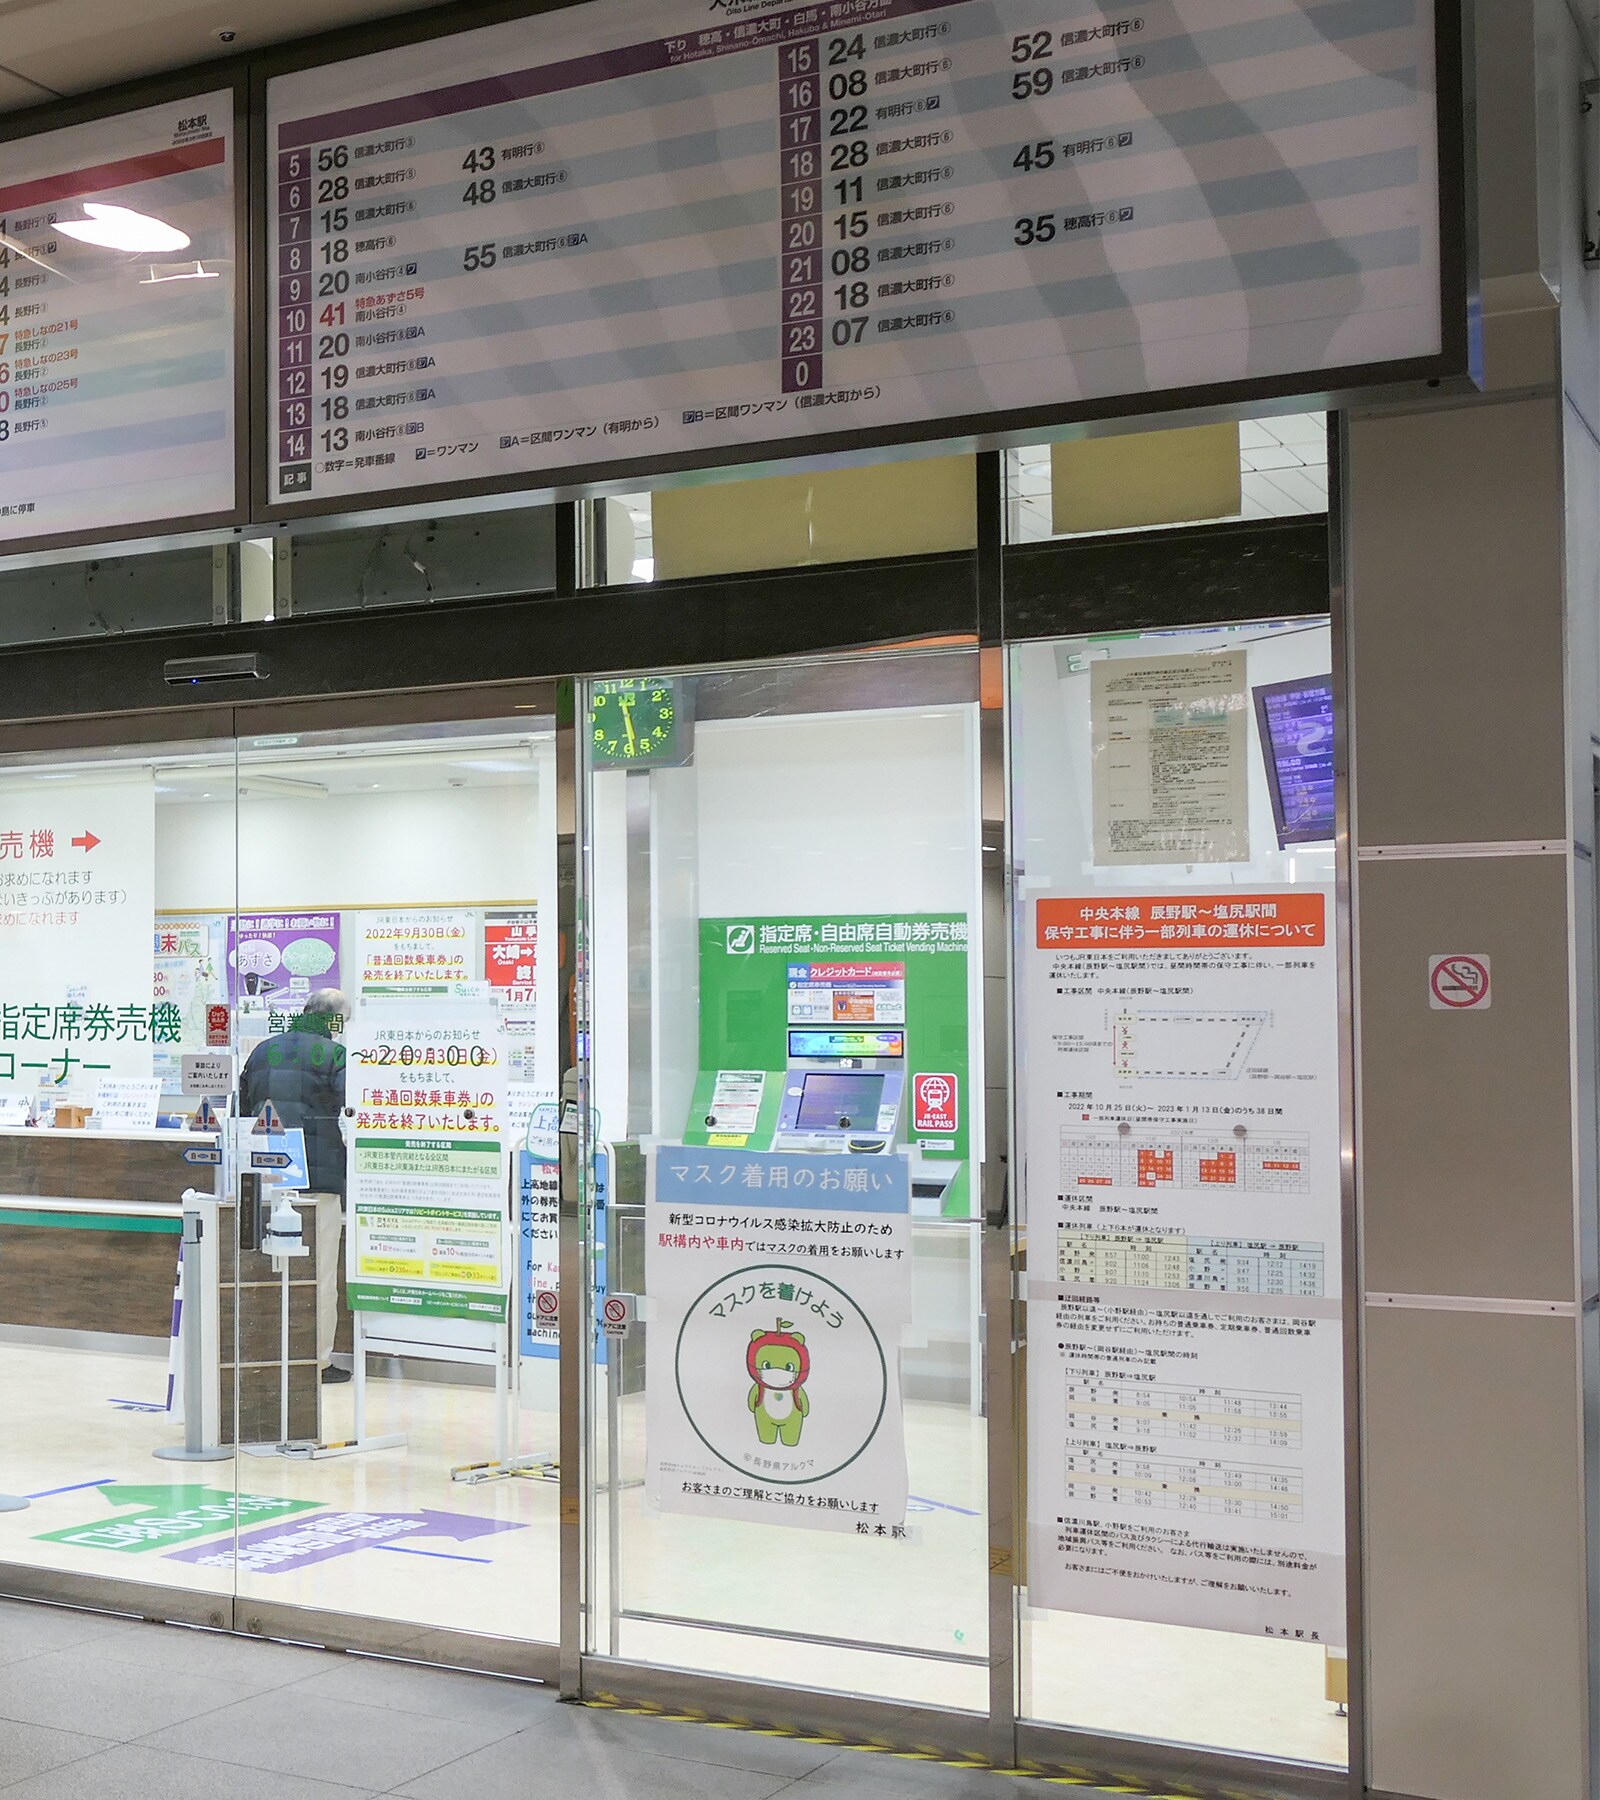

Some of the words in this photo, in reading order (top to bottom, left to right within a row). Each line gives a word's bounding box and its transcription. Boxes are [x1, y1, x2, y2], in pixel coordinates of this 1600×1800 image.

[788, 46, 811, 73] 15
[828, 33, 866, 66] 24
[1011, 30, 1053, 64] 52
[829, 70, 868, 100] 08
[1012, 68, 1053, 100] 59
[790, 117, 812, 143] 17
[829, 104, 868, 137] 22
[289, 154, 300, 177] 5
[318, 145, 349, 172] 56
[462, 146, 495, 173] 43
[830, 140, 869, 171] 28
[1013, 141, 1055, 172] 45
[289, 186, 300, 208] 6
[318, 176, 349, 203] 28
[463, 178, 496, 206] 48
[320, 207, 349, 233] 15
[789, 220, 815, 249] 20
[834, 210, 868, 241] 15
[1014, 214, 1056, 247] 35
[290, 248, 300, 270] 8
[320, 238, 349, 265] 18
[290, 279, 300, 301] 9
[319, 270, 349, 297] 20
[286, 309, 305, 333] 10
[319, 301, 345, 327] 41
[789, 325, 815, 353] 23
[832, 315, 869, 347] 07
[287, 372, 305, 395] 12
[321, 364, 349, 390] 19
[640, 680, 647, 691] 1
[652, 691, 662, 701] 2
[659, 708, 669, 719] 3
[608, 740, 617, 751] 7
[640, 739, 650, 749] 5
[376, 915, 453, 923] JR東日本からのお知らせ
[1080, 906, 1141, 921] 中央本線
[760, 922, 968, 944] 指定席・自由席自動券売機
[1044, 922, 1316, 940] 保守工事に伴う一部列車の運休について
[760, 944, 792, 953] Reserved
[865, 943, 883, 953] Seat
[884, 943, 905, 952] Ticket
[906, 943, 936, 954] Vending
[937, 943, 968, 952] Machine
[363, 969, 468, 981] 発売を終了いたします。
[810, 966, 872, 978] クレジットカード
[374, 1030, 480, 1041] JR東日本からのお知らせ
[356, 1113, 500, 1132] 発売を終了いたします。
[917, 1120, 933, 1128] RAIL
[934, 1120, 953, 1128] PASS
[670, 1162, 894, 1193] マスク着用のお願い
[668, 1212, 894, 1237] 新型コロナウイルス感染拡大防止のため
[658, 1233, 905, 1260] 駅構内や車内ではマスクの着用をお願いします
[708, 1281, 845, 1330] マスクを着けよう
[681, 1481, 880, 1514] お客さまのご理解とご協力をお願いします
[855, 1521, 906, 1539] 松本駅
